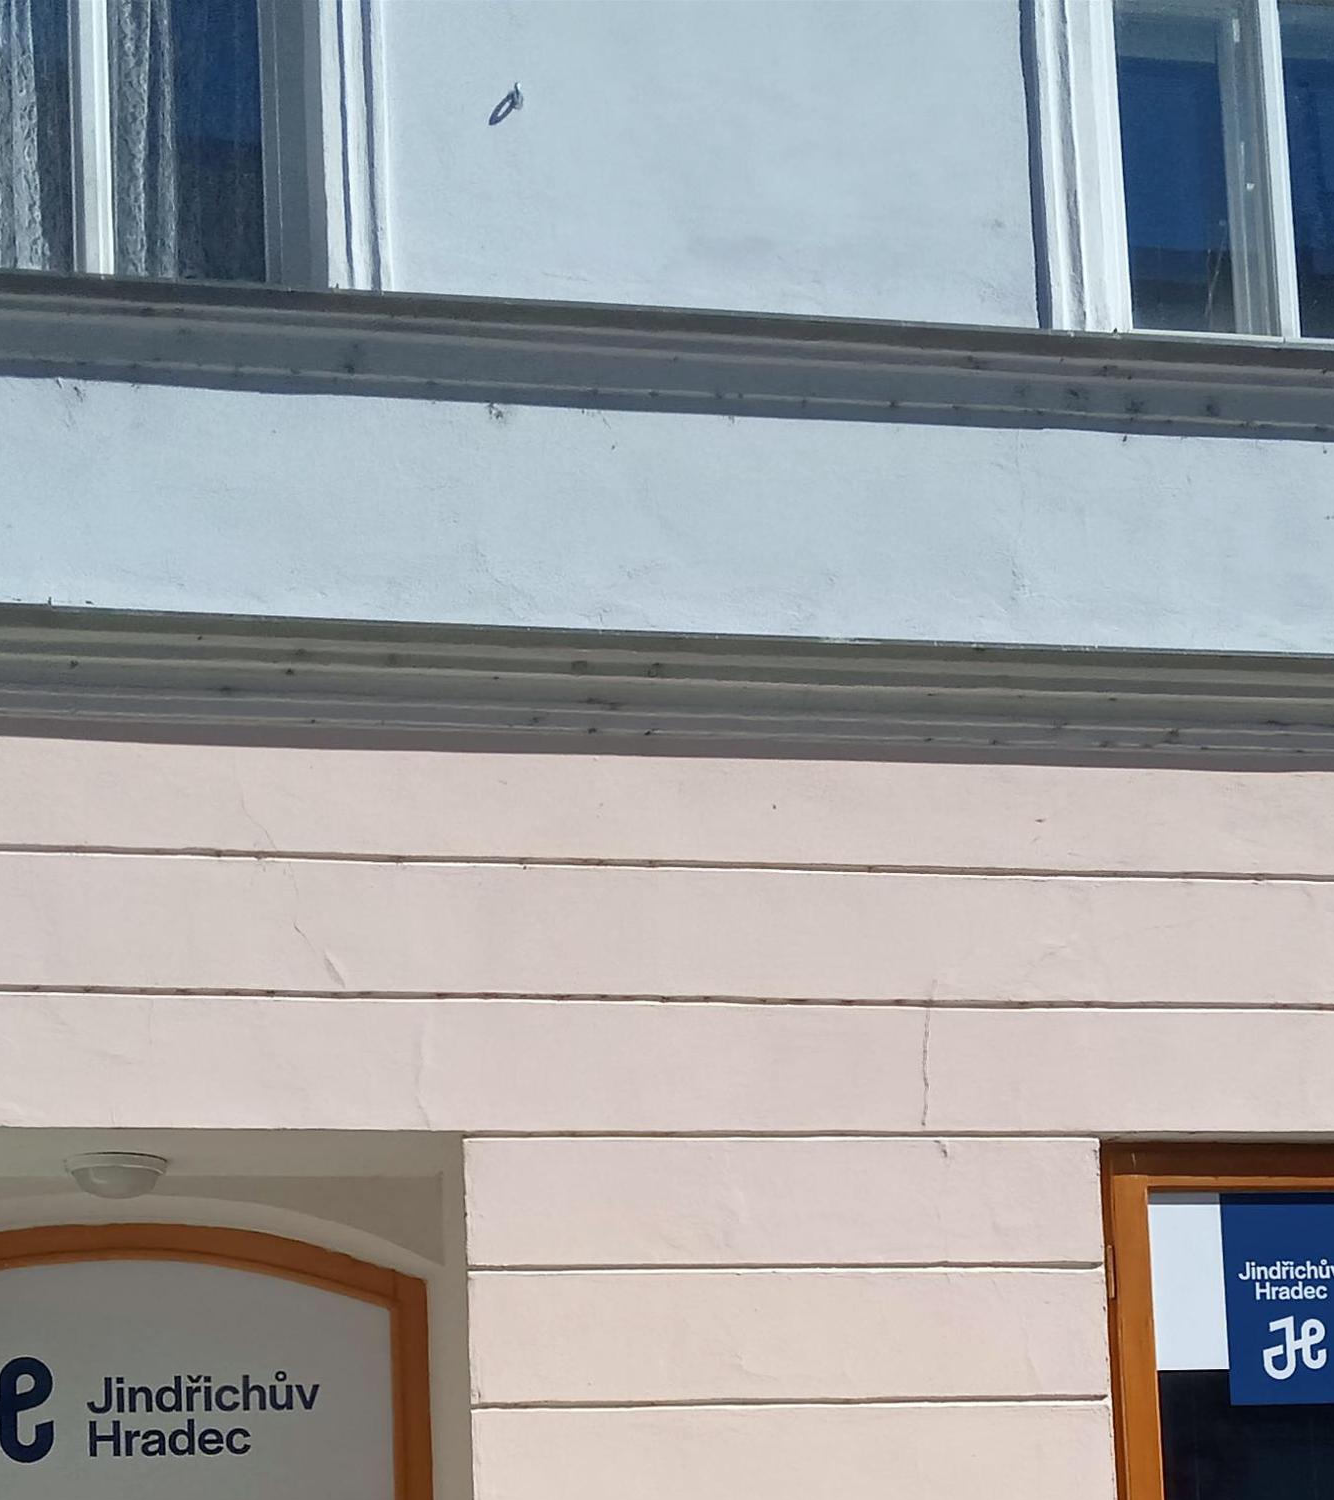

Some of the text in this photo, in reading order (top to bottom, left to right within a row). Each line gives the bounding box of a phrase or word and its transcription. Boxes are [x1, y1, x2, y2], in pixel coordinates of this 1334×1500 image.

[1254, 1280, 1328, 1301] Hradec
[86, 1370, 320, 1414] Jindřichův
[88, 1420, 252, 1458] Hradec
